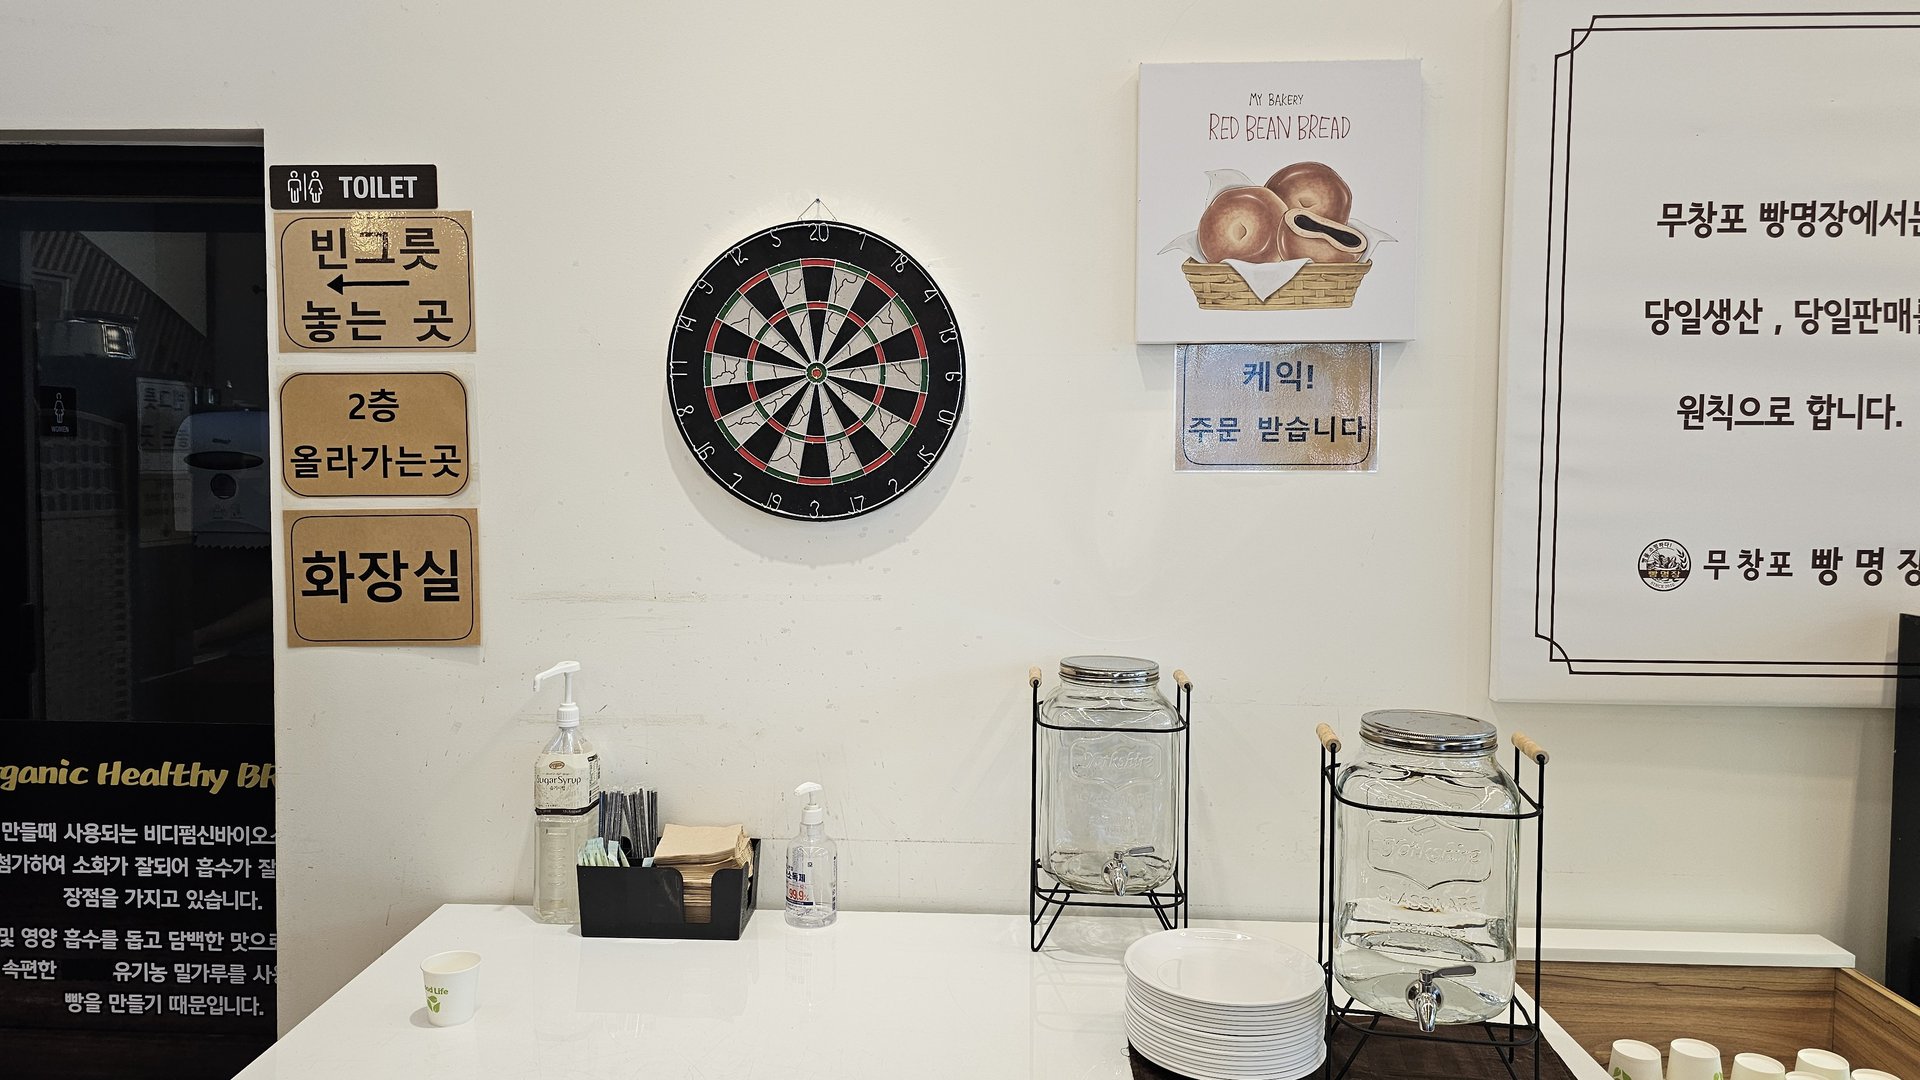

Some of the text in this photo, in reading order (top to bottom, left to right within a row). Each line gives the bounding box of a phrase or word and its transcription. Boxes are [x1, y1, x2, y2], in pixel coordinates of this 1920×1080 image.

[1249, 93, 1304, 106] MY BAKERY
[1209, 113, 1351, 141] RED BEAN BREAD
[338, 176, 418, 199] TOILET
[1657, 200, 1747, 238] 무창포
[770, 229, 782, 247] 5
[808, 222, 829, 242] 20
[312, 228, 440, 270] 빈그릇
[727, 247, 749, 266] 12
[891, 250, 909, 273] 18
[697, 279, 714, 295] 9
[924, 289, 939, 303] 4
[302, 300, 453, 343] 놓는 곳
[676, 314, 697, 332] 14
[1645, 298, 1763, 335] 당일생산
[1794, 298, 1920, 335] 당일판매
[939, 321, 958, 343] 13
[1243, 361, 1314, 392] 케익!
[348, 389, 399, 422] 2층
[677, 405, 694, 417] 8
[1677, 394, 1902, 431] 원칙으로 합니다.
[937, 410, 956, 430] 10
[1188, 416, 1366, 442] 주문 받습니다
[290, 444, 461, 478] 올라가는곳
[694, 441, 715, 461] 16
[917, 445, 936, 468] 15
[729, 472, 743, 490] 7
[888, 478, 904, 494] 2
[763, 492, 782, 511] 19
[809, 500, 820, 519] 3
[848, 495, 865, 514] 17
[1704, 548, 1793, 581] 무창포
[302, 550, 460, 603] 화장실
[0, 759, 88, 791] ganic
[97, 761, 228, 794] Healthy
[536, 775, 582, 785] Sugar Syrup
[2, 822, 276, 846] 만들때 사용되는 비디펌신바이오
[72, 855, 128, 876] 소화가
[134, 857, 188, 877] 잘되어
[196, 857, 252, 878] 흡수가
[63, 887, 263, 910] 장점을 가지고 있습니다.
[0, 927, 14, 947] 및
[21, 928, 58, 949] 영양
[63, 928, 119, 950] 흡수를
[125, 930, 163, 950] 돕고
[168, 931, 225, 952] 담백한
[2, 959, 277, 985] 속편한 유기농 밀가루를 사
[64, 992, 264, 1016] 빵을 만들기 때문입니다.
